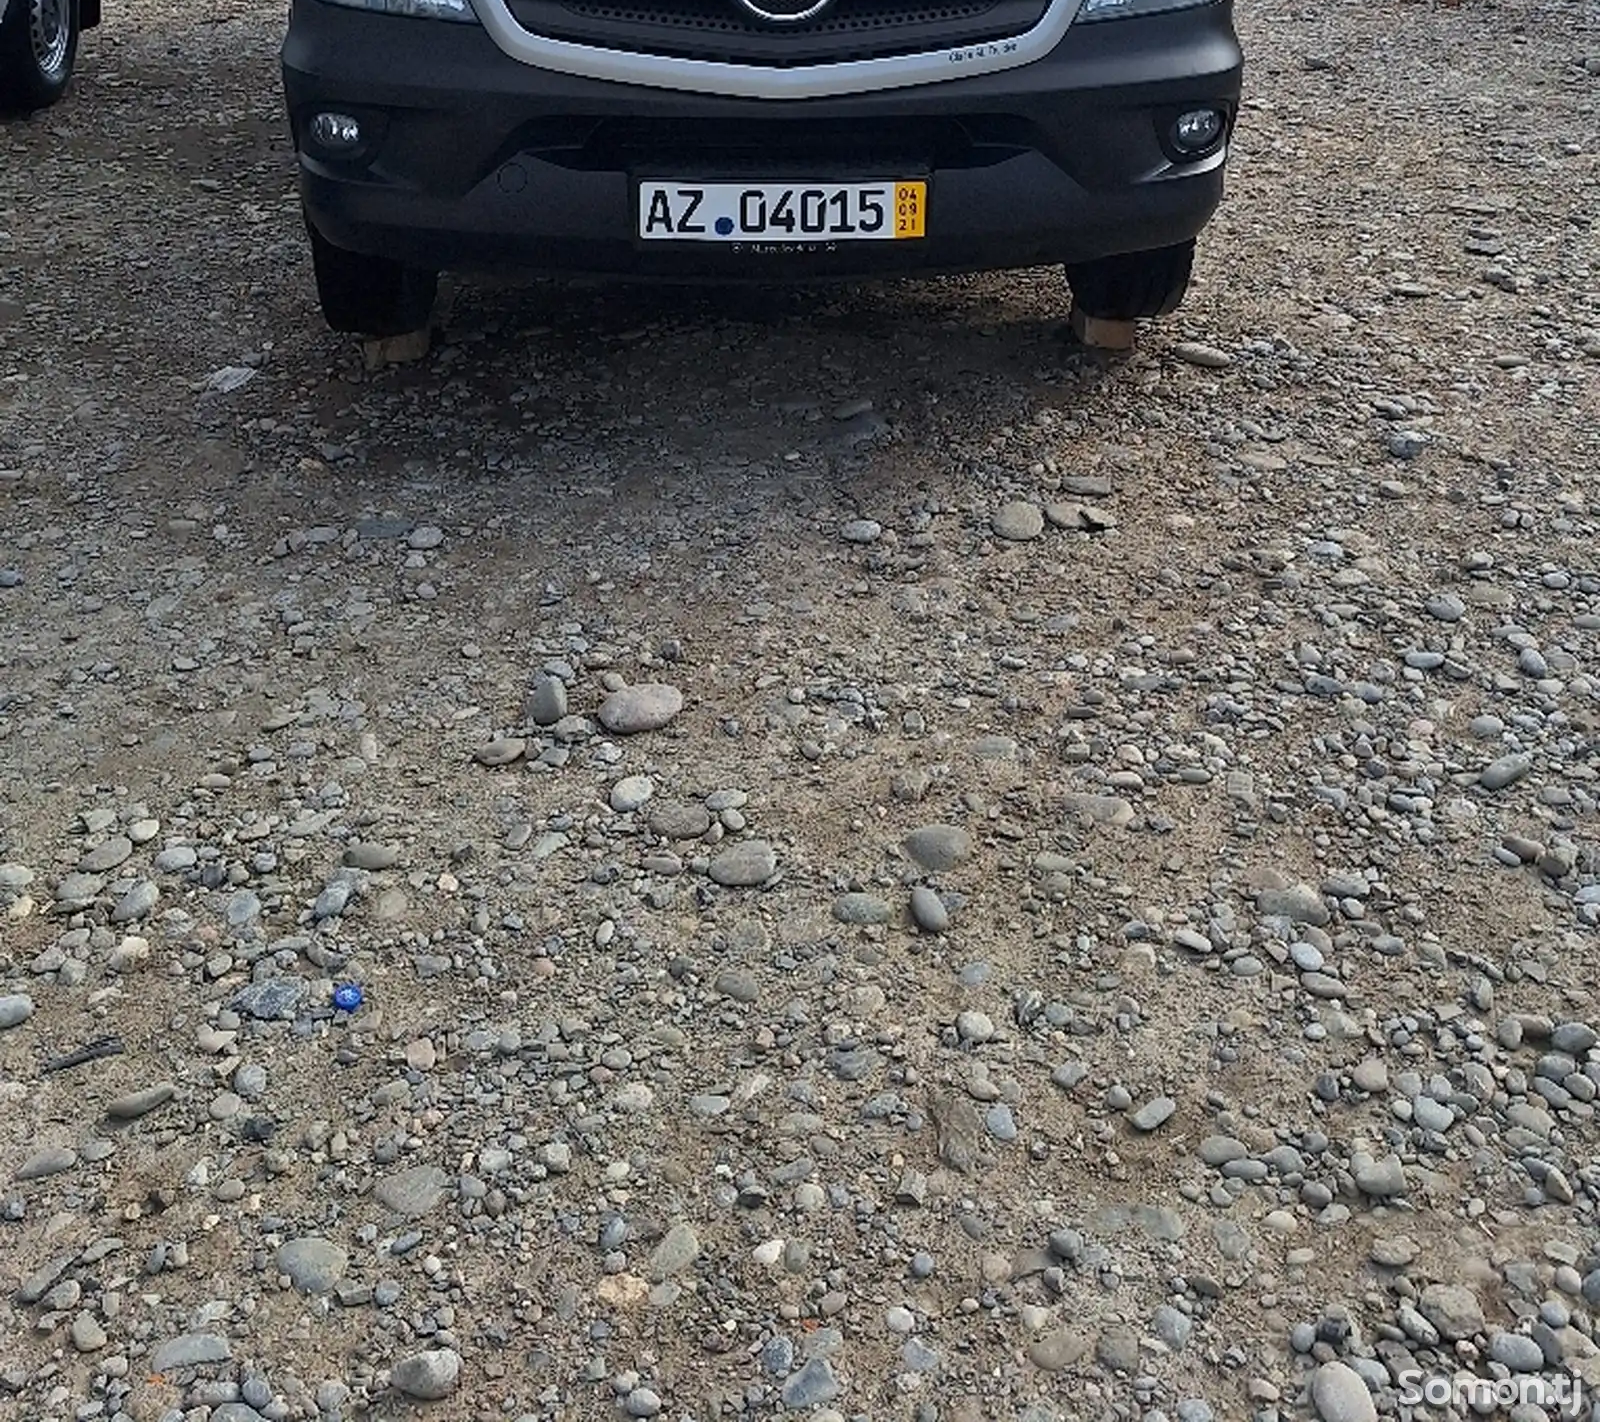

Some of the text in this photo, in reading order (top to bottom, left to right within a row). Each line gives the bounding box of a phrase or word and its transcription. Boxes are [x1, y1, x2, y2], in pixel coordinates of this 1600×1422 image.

[898, 188, 917, 200] 04
[646, 189, 885, 233] AZ 04015
[898, 204, 917, 216] 09
[898, 219, 917, 231] 21
